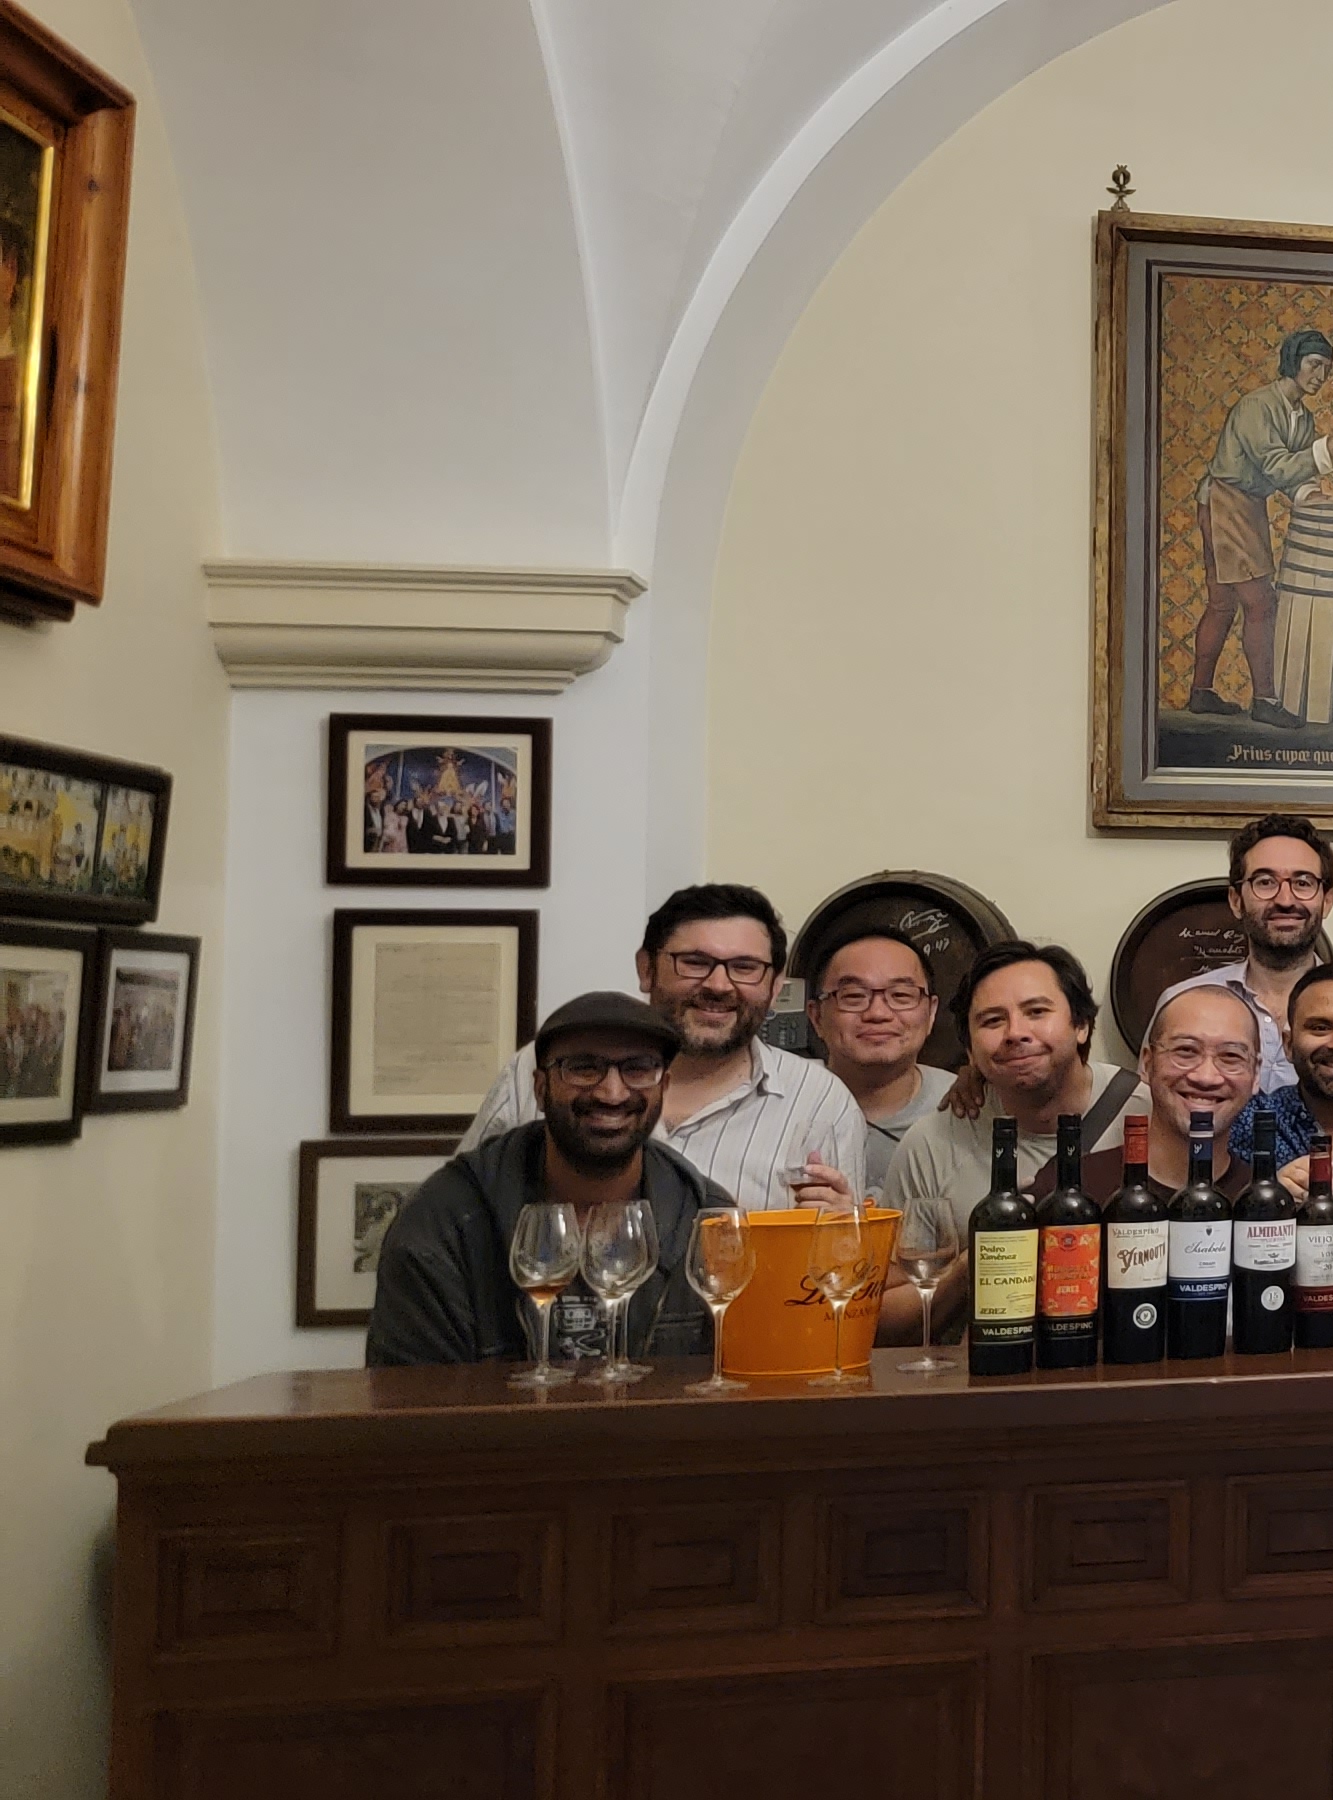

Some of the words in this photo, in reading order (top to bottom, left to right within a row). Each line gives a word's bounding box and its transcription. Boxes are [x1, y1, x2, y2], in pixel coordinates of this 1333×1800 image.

[1226, 744, 1272, 763] Prius
[1112, 1228, 1159, 1236] VALDESPINO
[980, 1245, 1006, 1253] Pedro
[980, 1278, 991, 1286] EL
